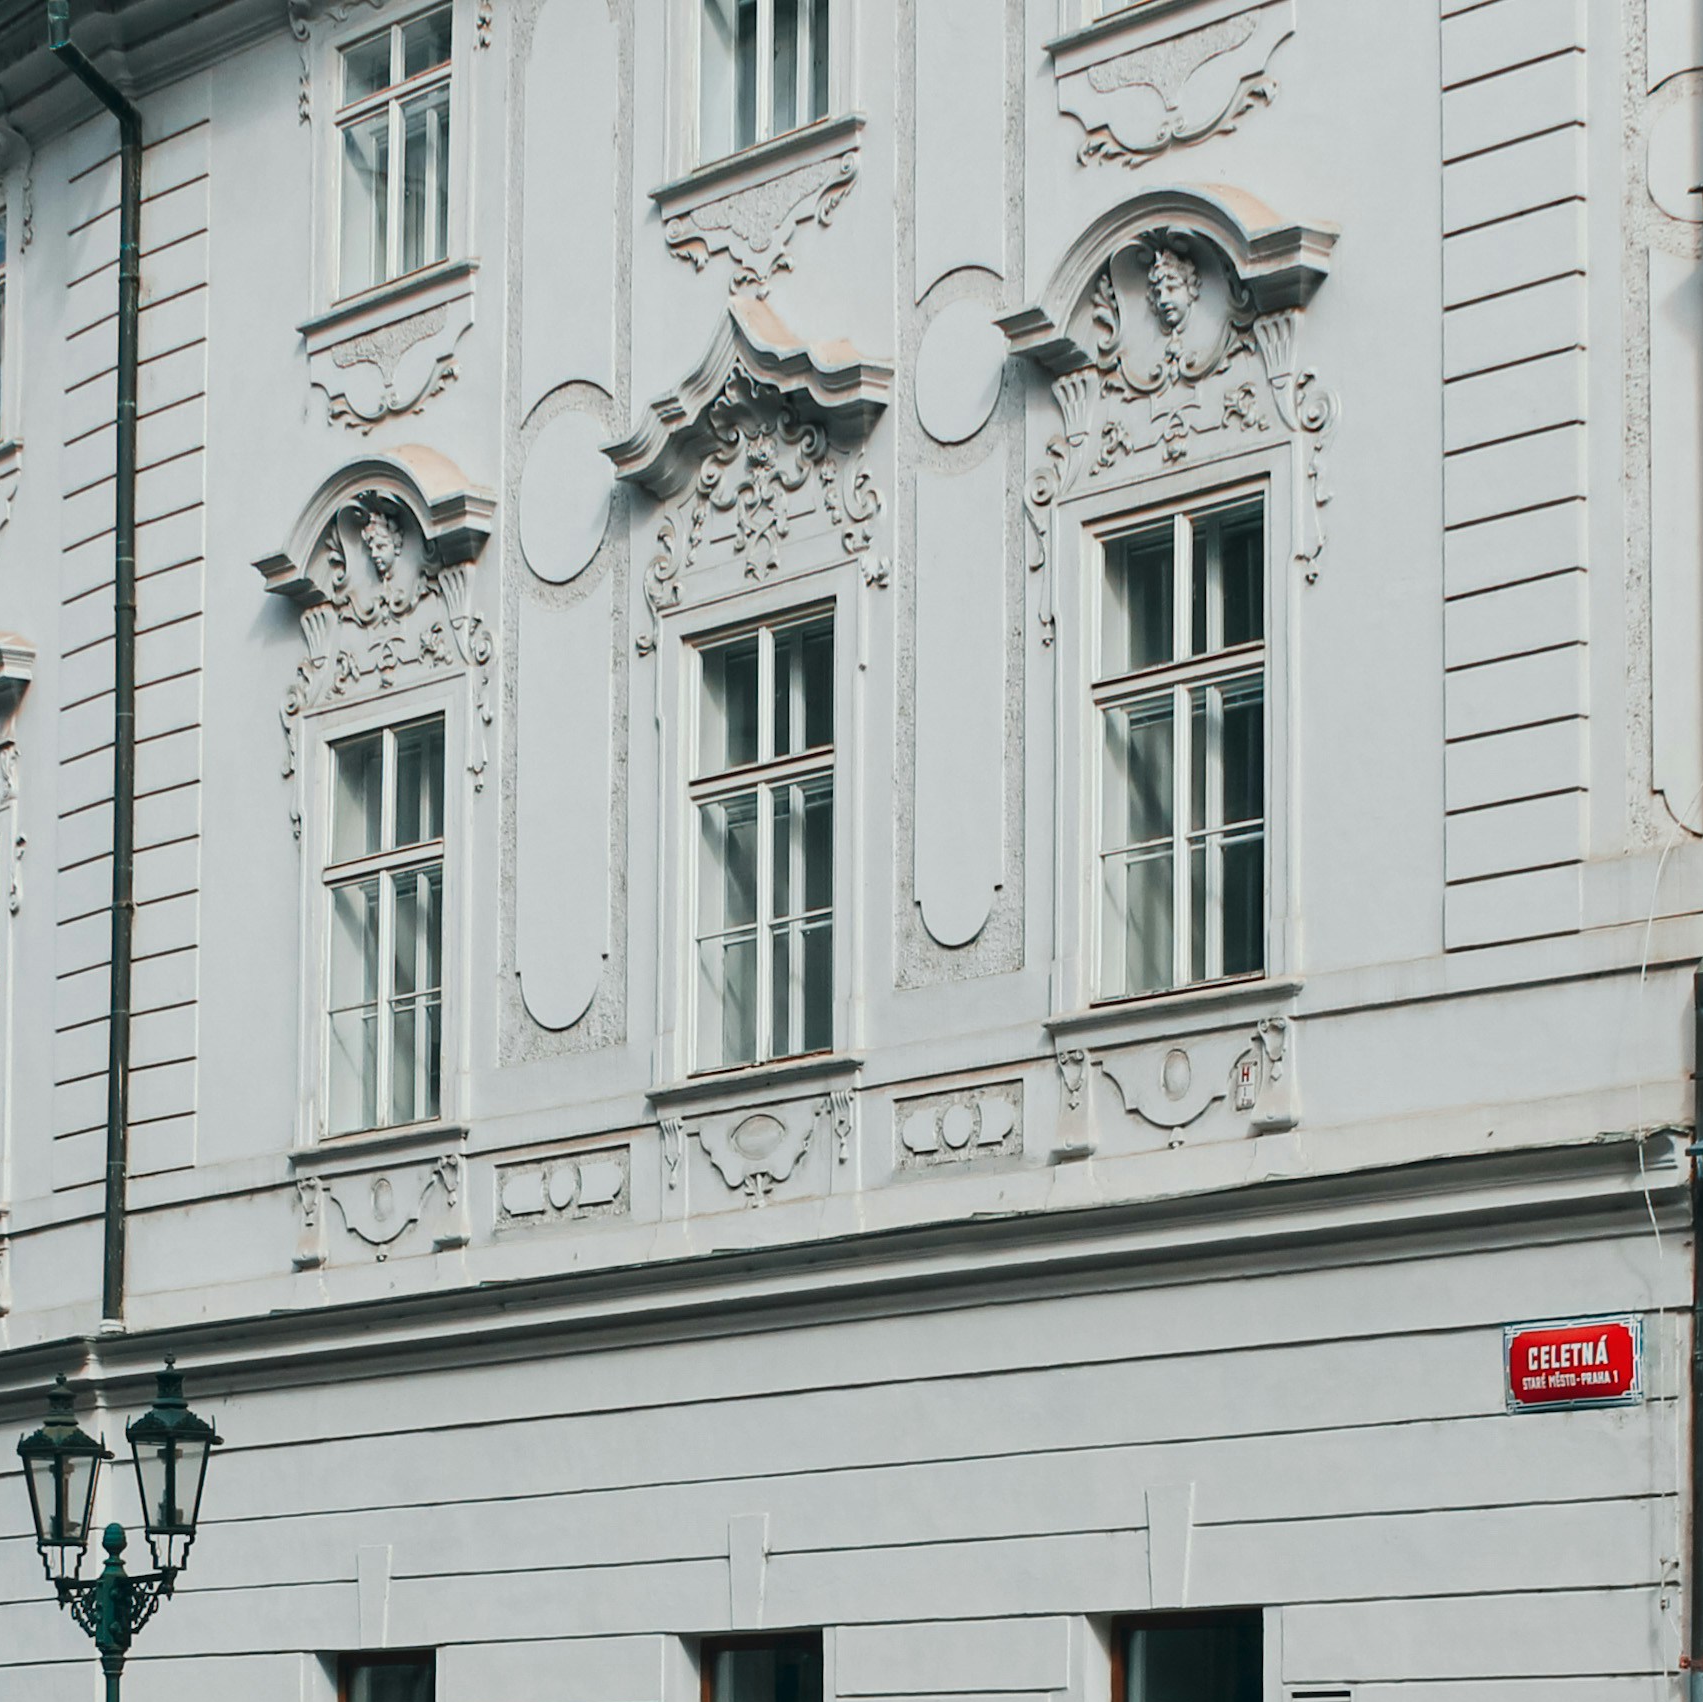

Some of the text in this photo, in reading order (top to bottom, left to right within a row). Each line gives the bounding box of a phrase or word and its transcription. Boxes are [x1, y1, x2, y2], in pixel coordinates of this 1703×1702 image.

[1527, 1334, 1609, 1371] CELETNÁ
[1522, 1373, 1546, 1391] STARÉ
[1613, 1369, 1619, 1384] 1
